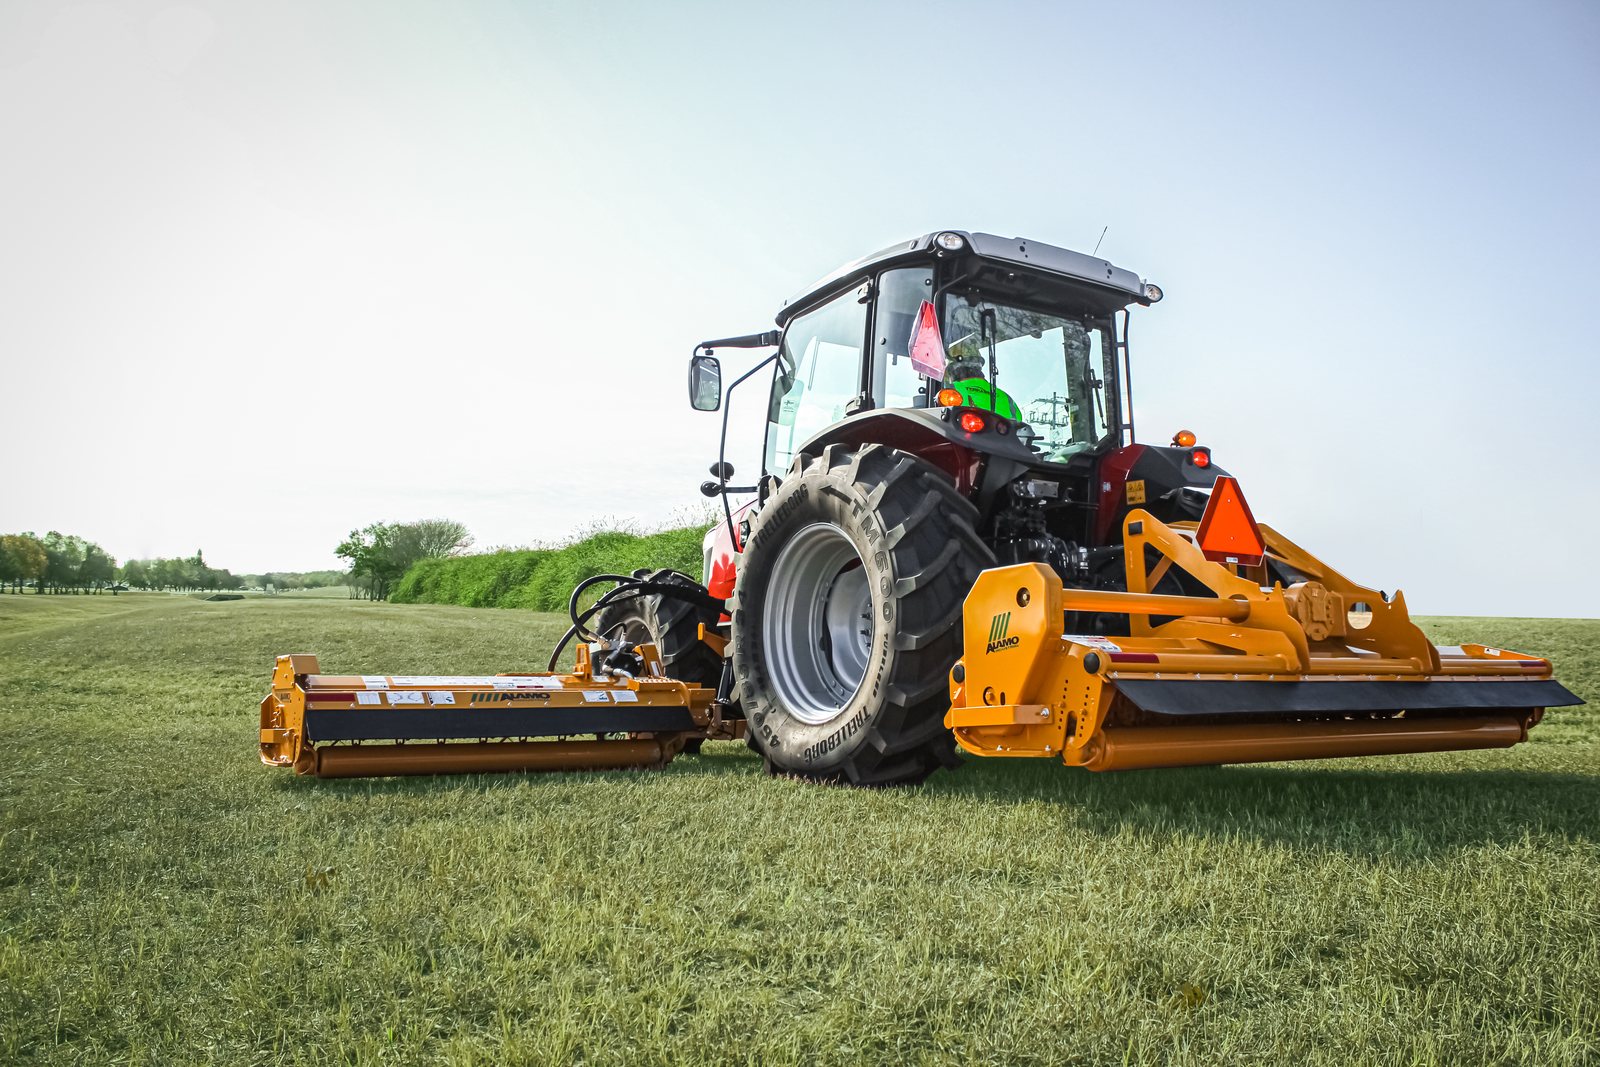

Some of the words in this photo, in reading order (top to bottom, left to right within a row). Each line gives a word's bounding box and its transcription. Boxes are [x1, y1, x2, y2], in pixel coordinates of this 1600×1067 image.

[752, 483, 809, 550] TRELLEBORG
[986, 636, 1019, 655] ALAMO
[501, 693, 550, 701] ALAMO
[804, 705, 872, 763] TRELLEBORG
